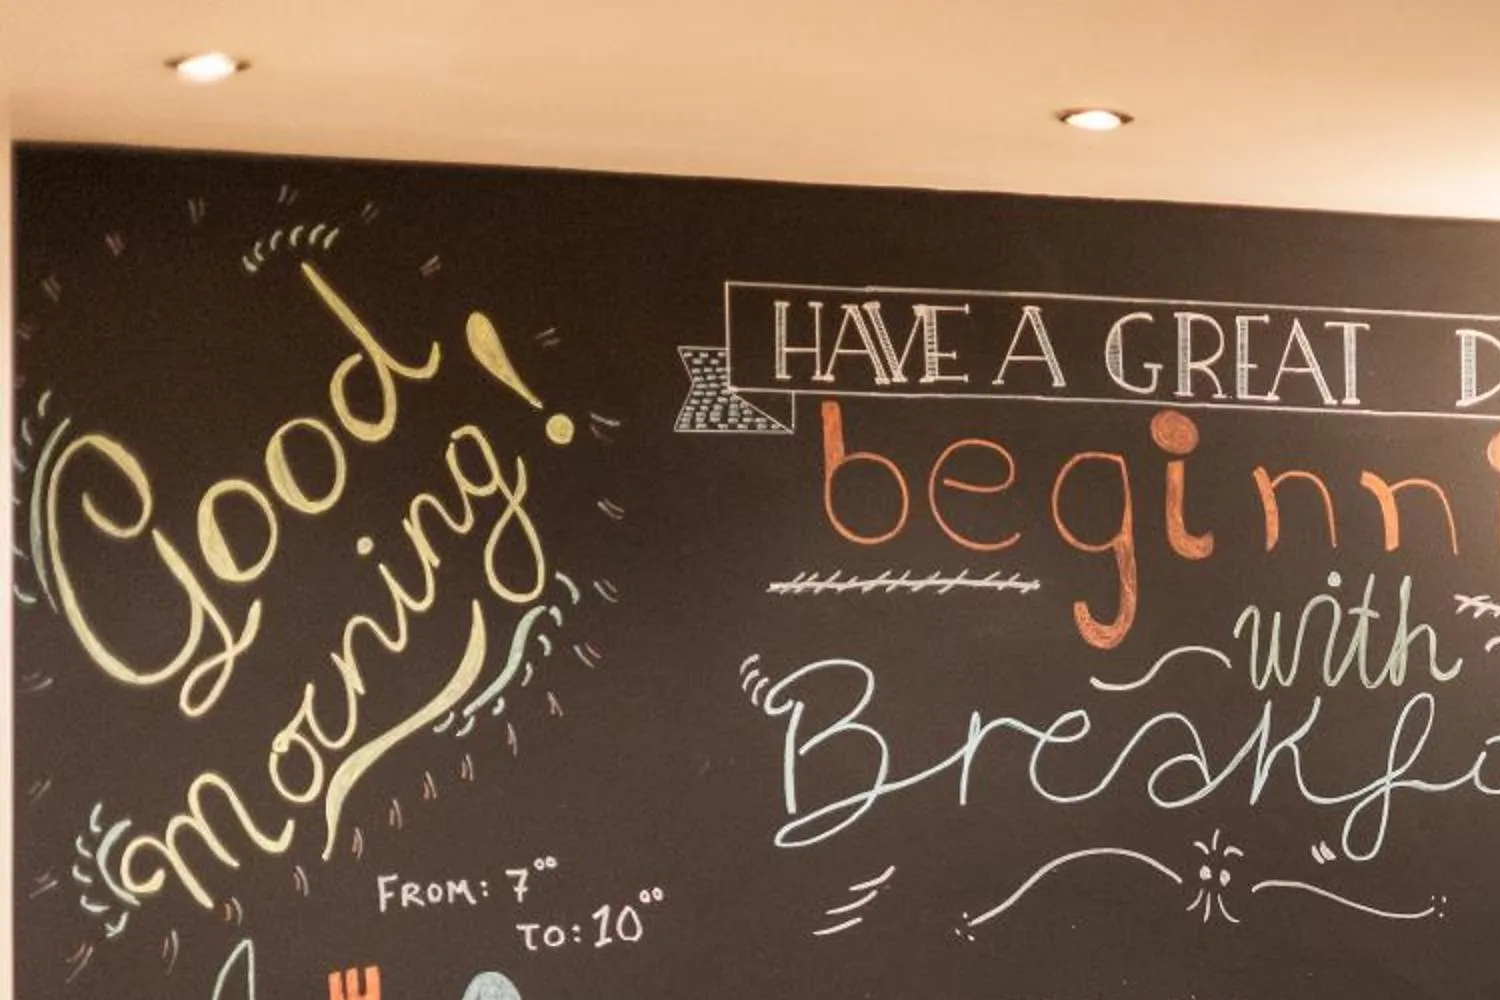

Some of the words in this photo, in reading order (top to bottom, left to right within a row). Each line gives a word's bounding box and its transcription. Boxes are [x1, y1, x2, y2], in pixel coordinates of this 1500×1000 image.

[774, 300, 970, 386] HAVE
[992, 305, 1067, 388] A
[1105, 310, 1371, 405] GREAT
[47, 262, 441, 717] Good
[1233, 572, 1463, 690] with
[377, 873, 489, 913] FROM:
